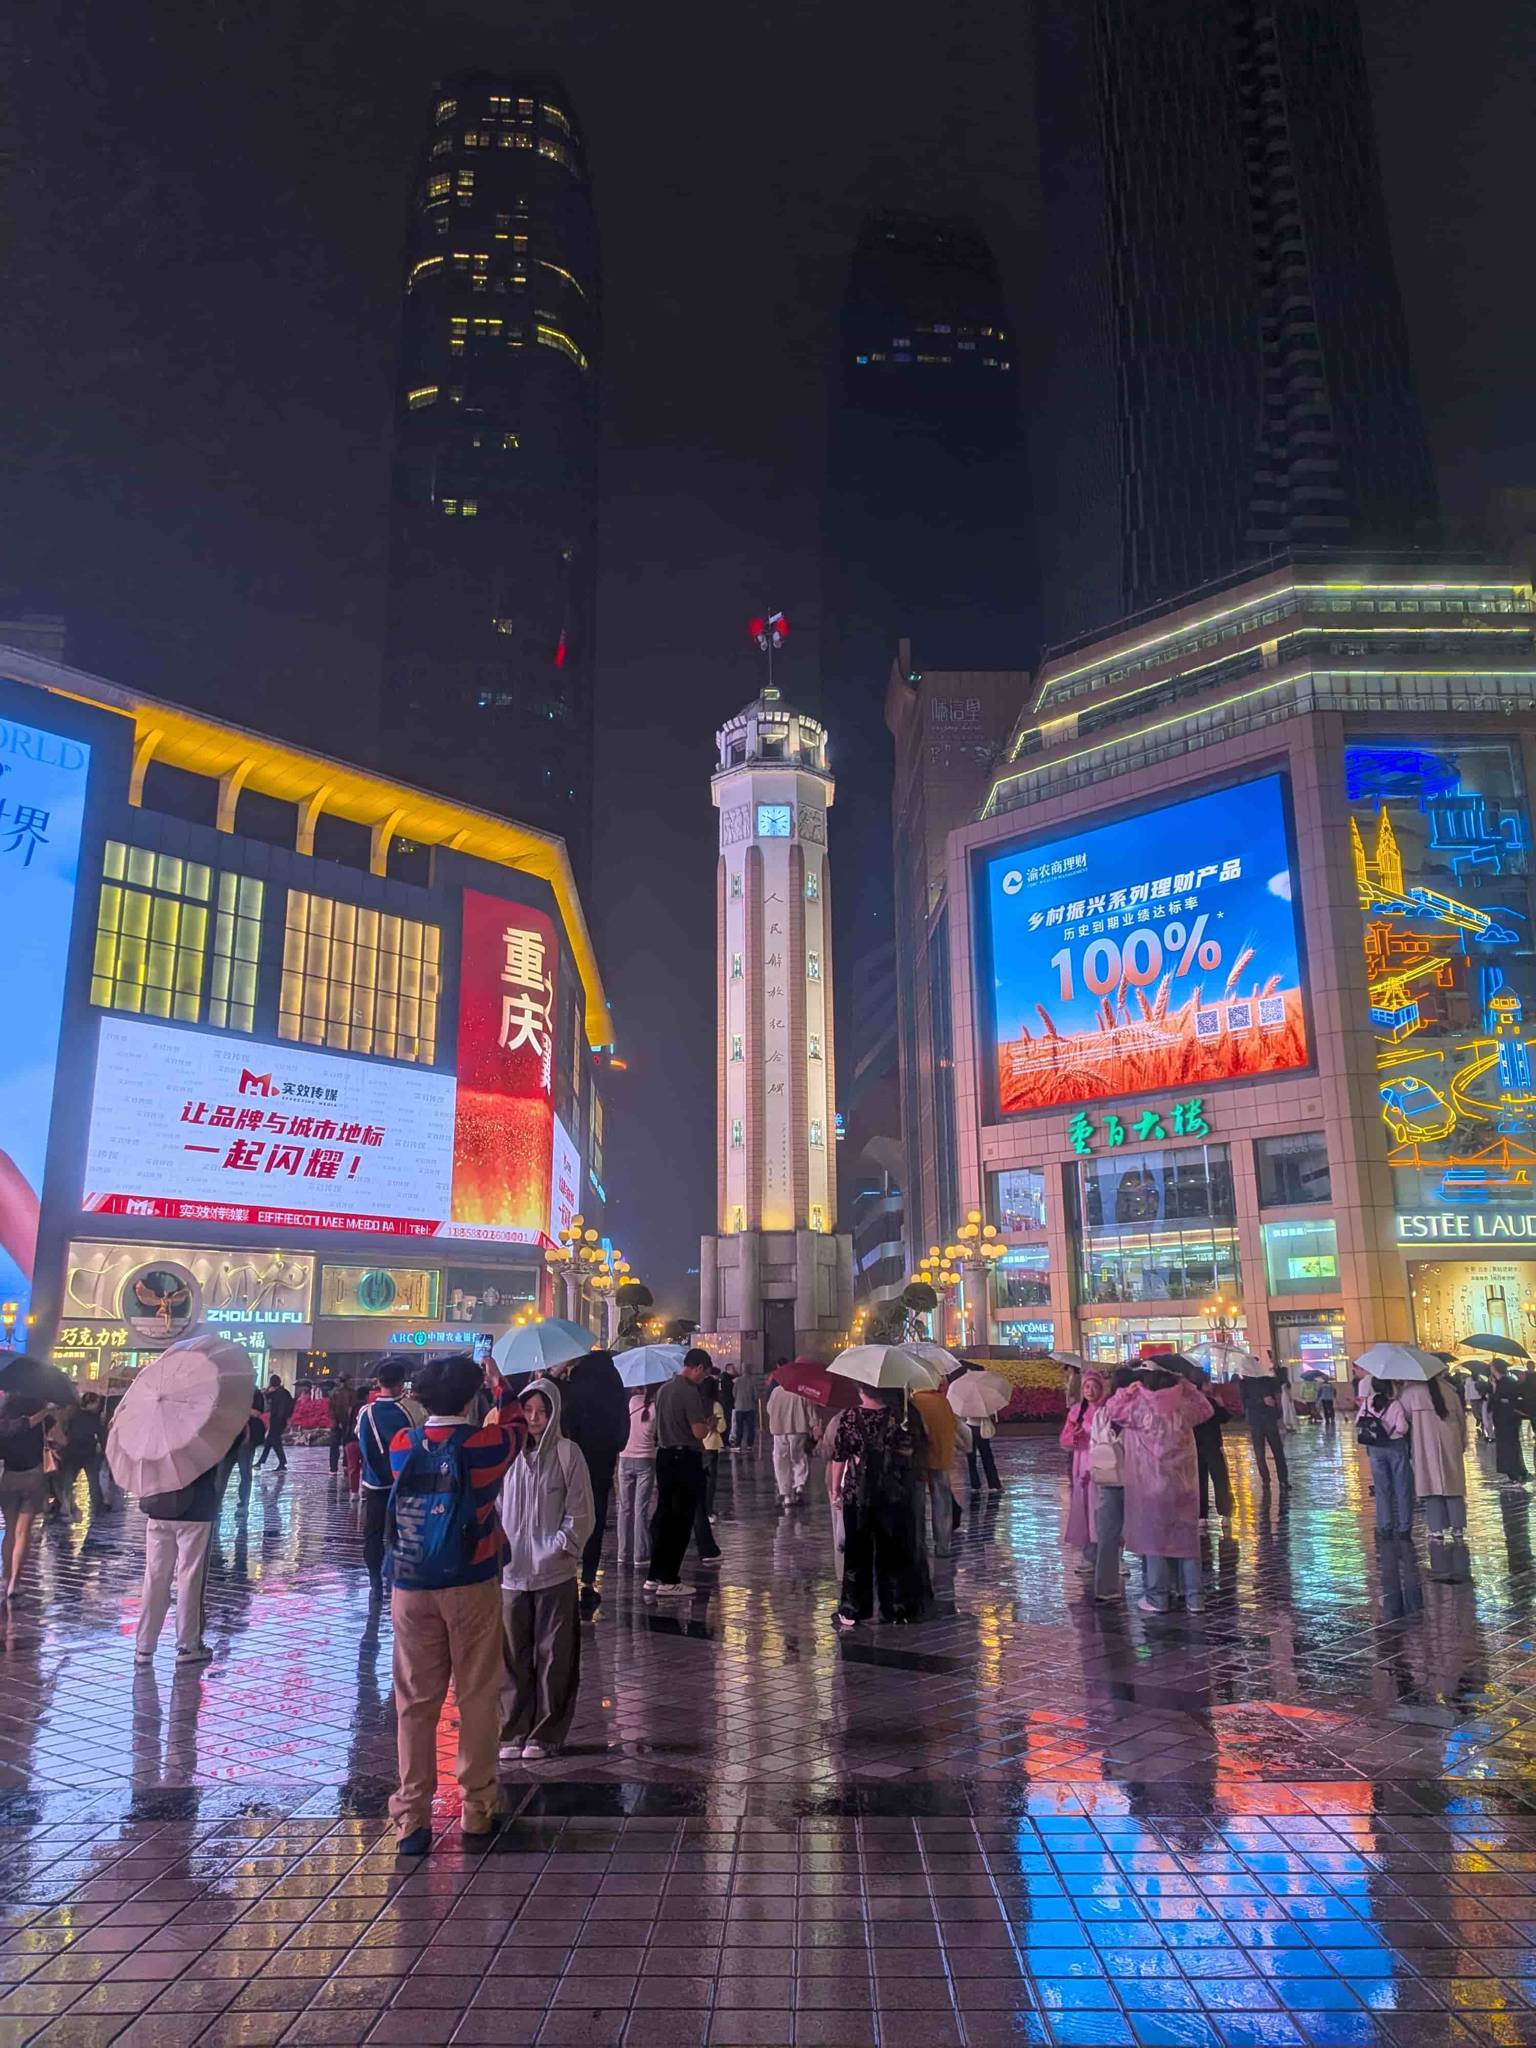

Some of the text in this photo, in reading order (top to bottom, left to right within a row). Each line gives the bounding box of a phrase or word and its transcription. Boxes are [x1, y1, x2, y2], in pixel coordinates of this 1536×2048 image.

[1026, 852, 1087, 882] 渝农商理财
[1027, 858, 1242, 932] 乡村振兴系列理财产品
[1063, 896, 1199, 941] 历史到期业绩达标率
[498, 927, 545, 1056] 重庆
[282, 1082, 338, 1102] 实效传媒
[180, 1101, 385, 1147] 让品牌与城市地标
[184, 1139, 361, 1179] 一起闪耀！
[207, 1309, 303, 1323] ZHOU LIU FU
[61, 1327, 128, 1346] 巧克力馆
